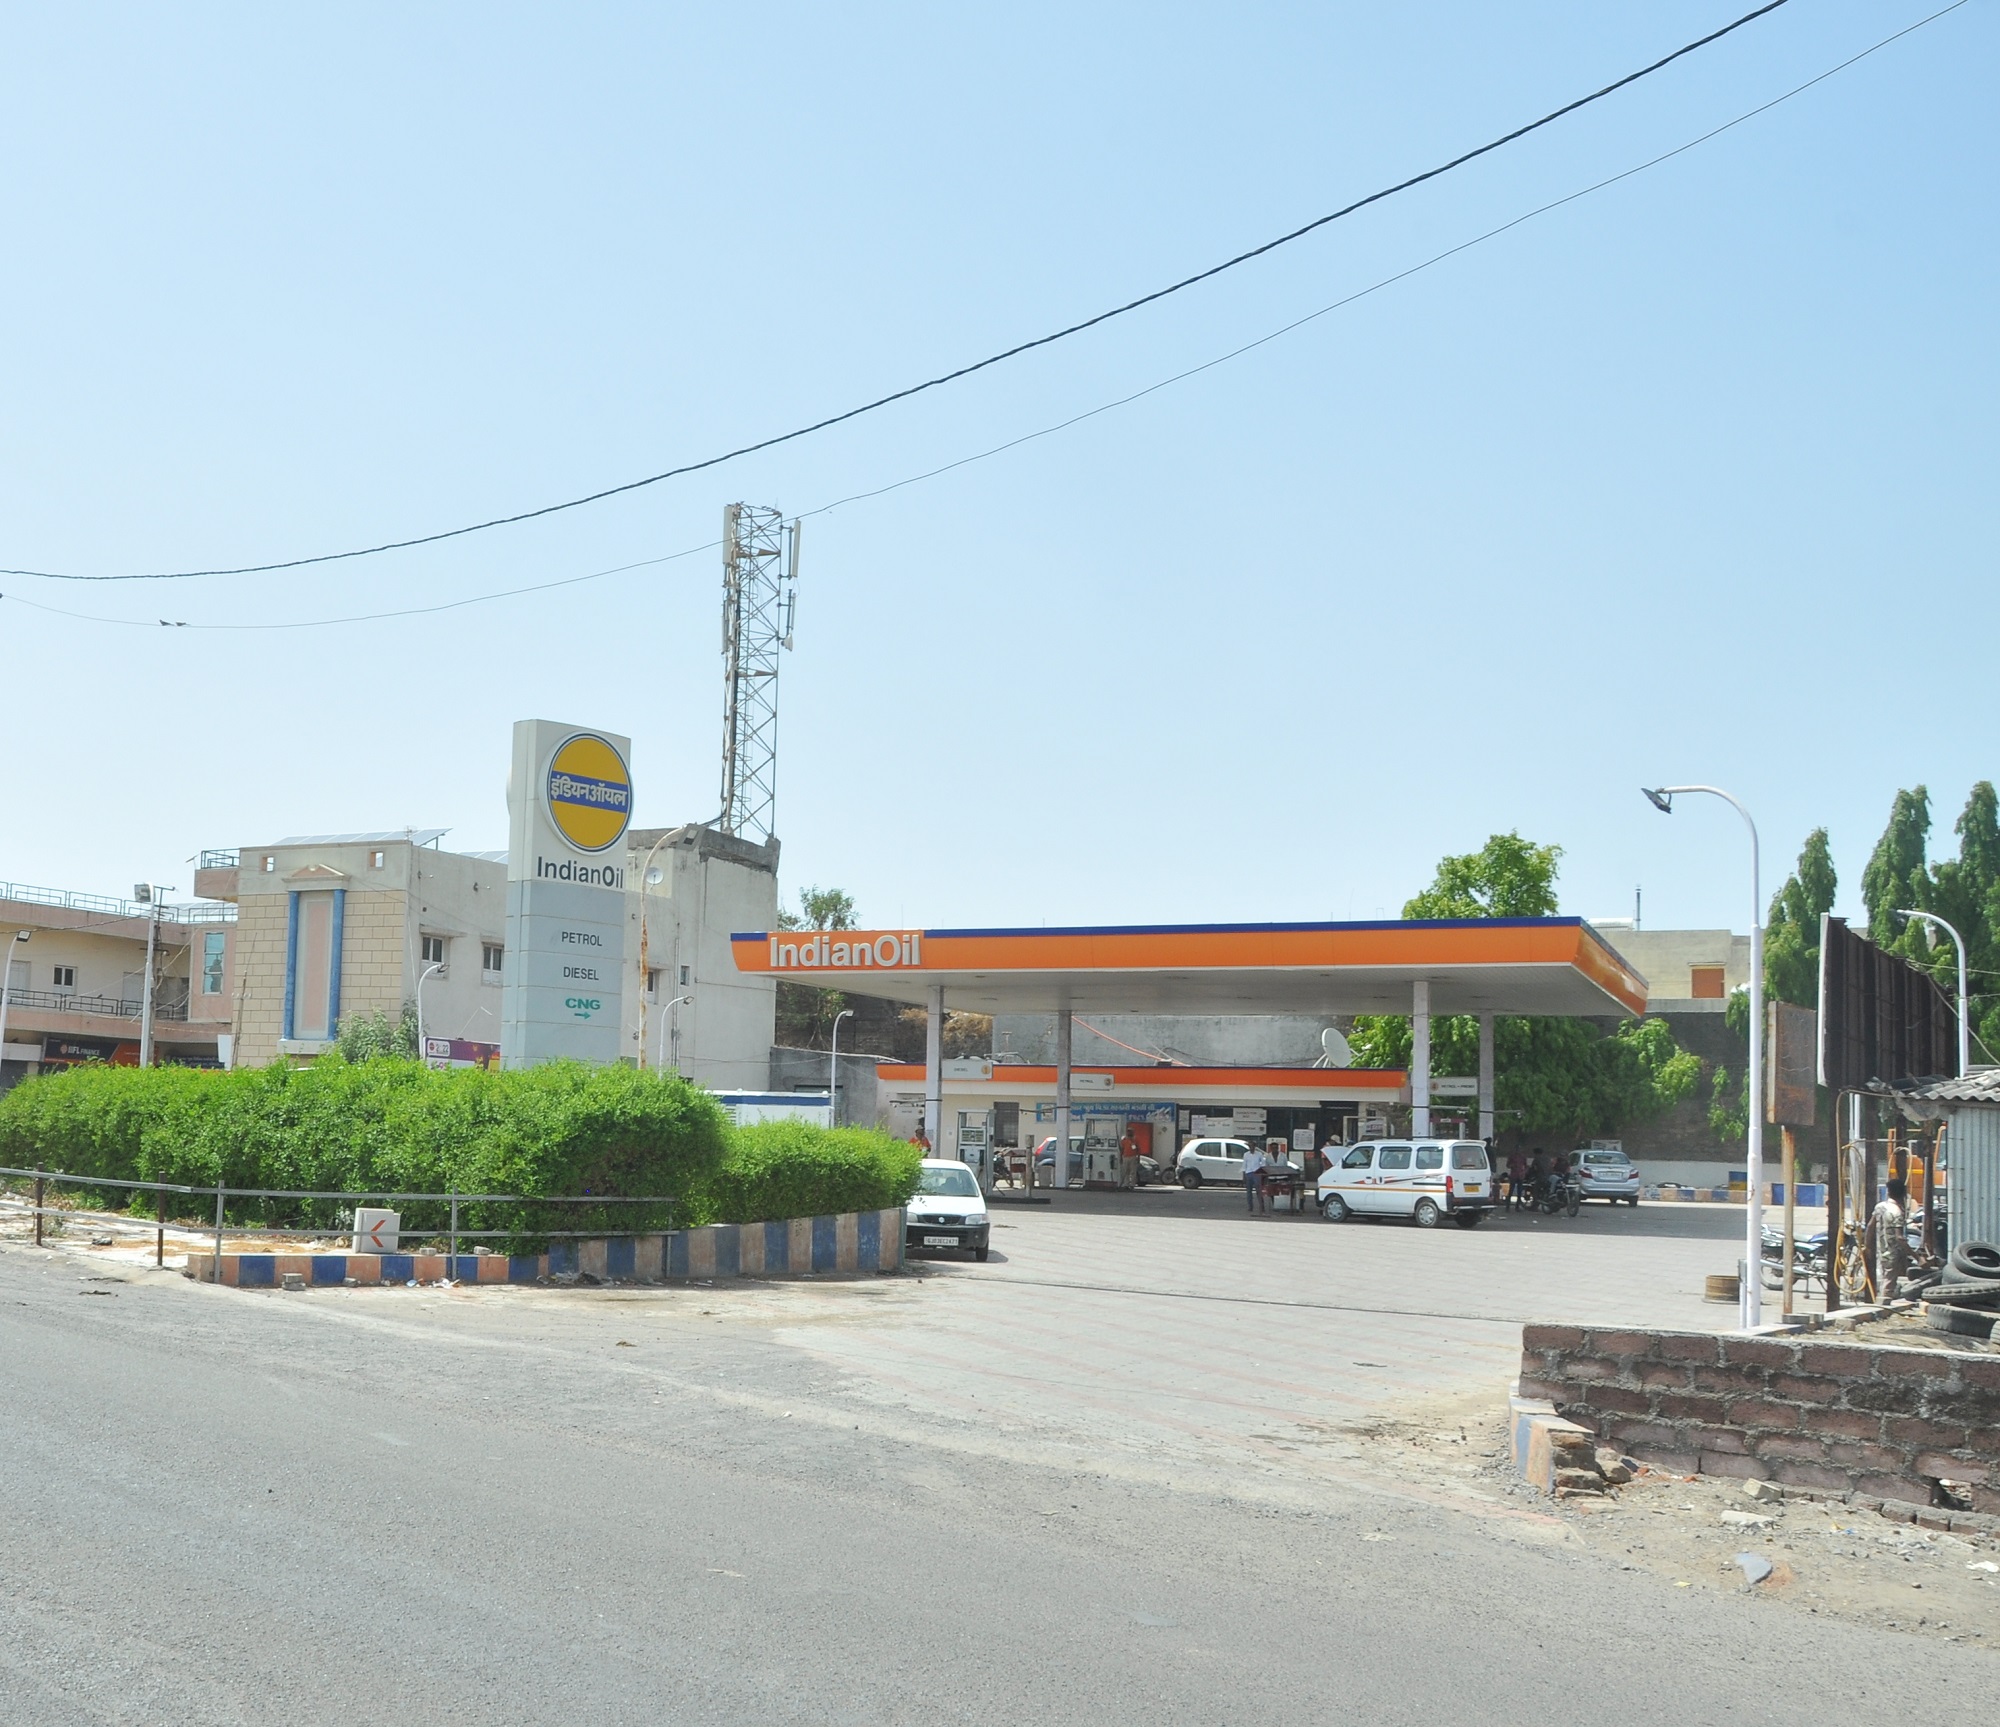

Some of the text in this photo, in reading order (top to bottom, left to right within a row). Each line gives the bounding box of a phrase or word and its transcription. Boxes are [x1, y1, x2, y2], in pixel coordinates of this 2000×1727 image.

[550, 776, 628, 807] इंडियनऑयल
[537, 856, 624, 890] IndianOil
[561, 931, 603, 947] PETROL
[770, 934, 921, 967] IndianOil
[563, 965, 600, 981] DIESEL
[565, 997, 601, 1011] CNG
[80, 1048, 101, 1056] FINANCE
